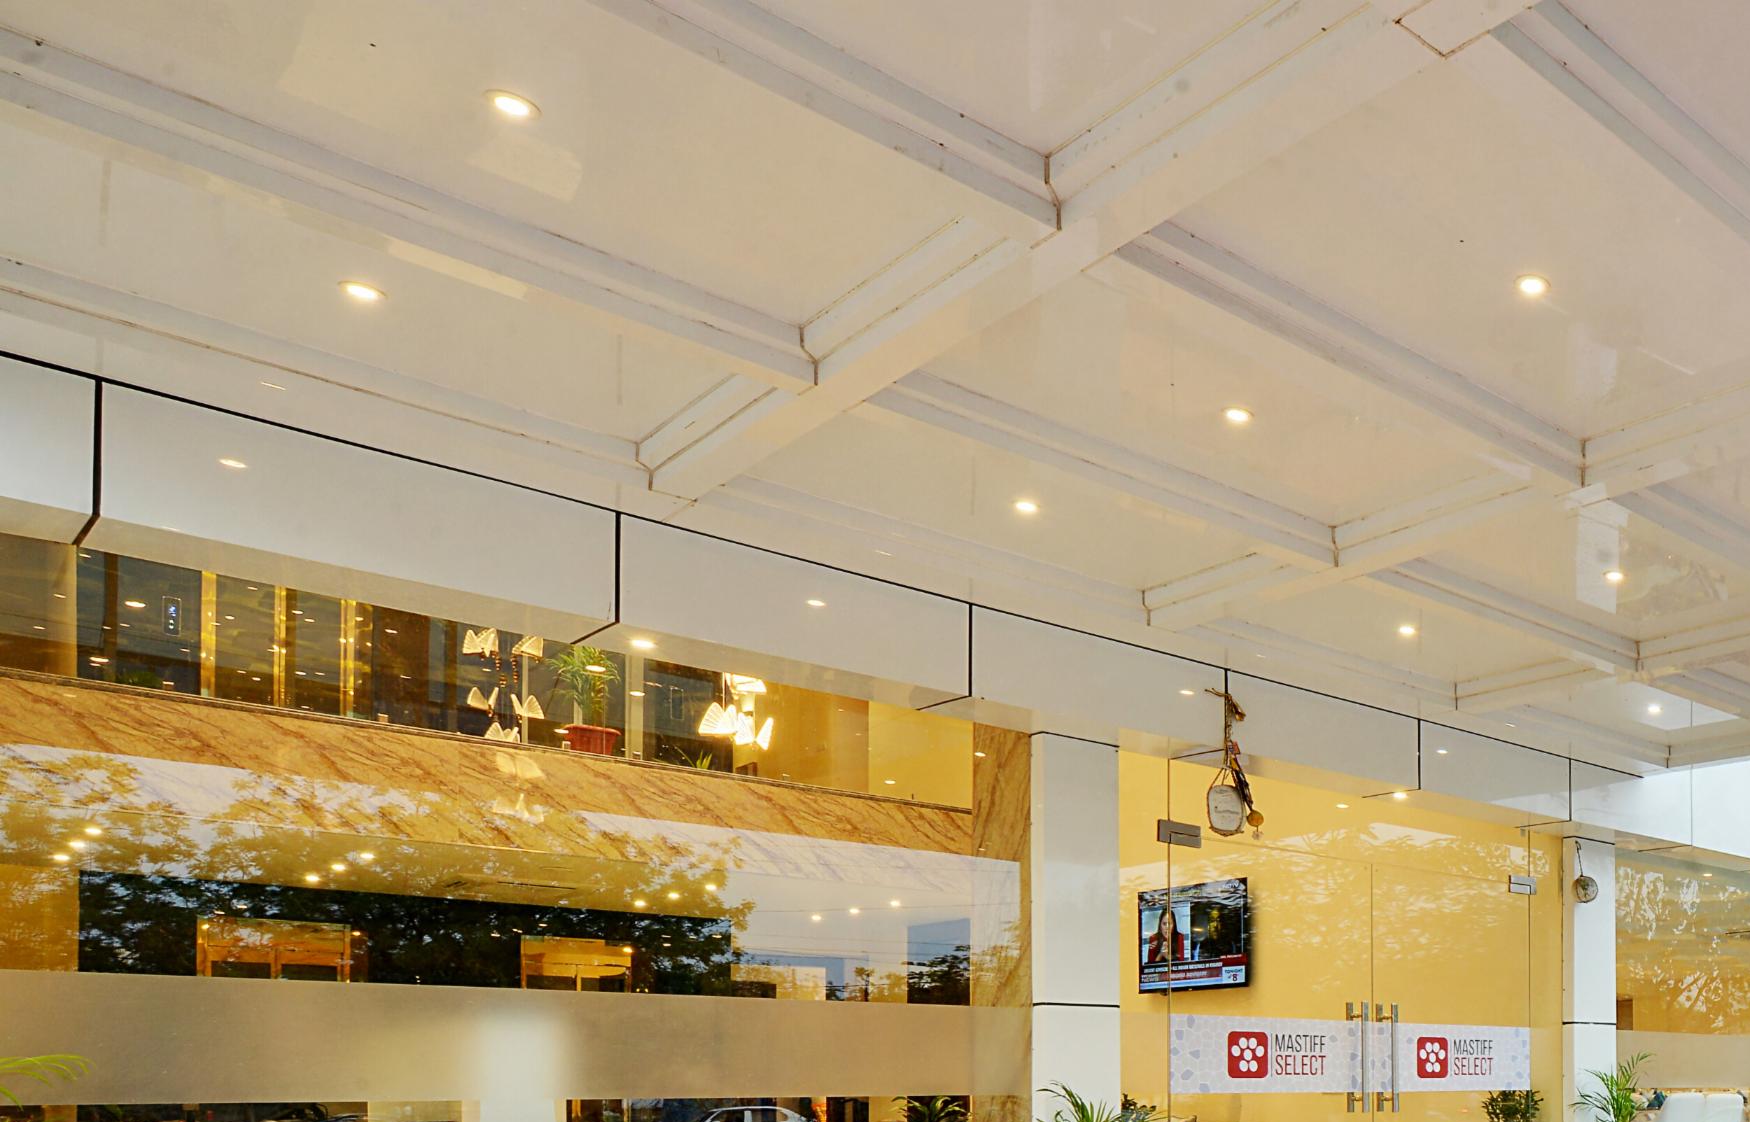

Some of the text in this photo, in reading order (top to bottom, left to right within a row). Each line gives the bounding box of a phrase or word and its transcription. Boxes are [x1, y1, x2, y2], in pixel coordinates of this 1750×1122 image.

[1275, 1034, 1327, 1053] MASTIFF
[1453, 1039, 1494, 1056] MASTIFF
[1275, 1054, 1327, 1076] SELECT
[1453, 1057, 1494, 1076] SELECT
